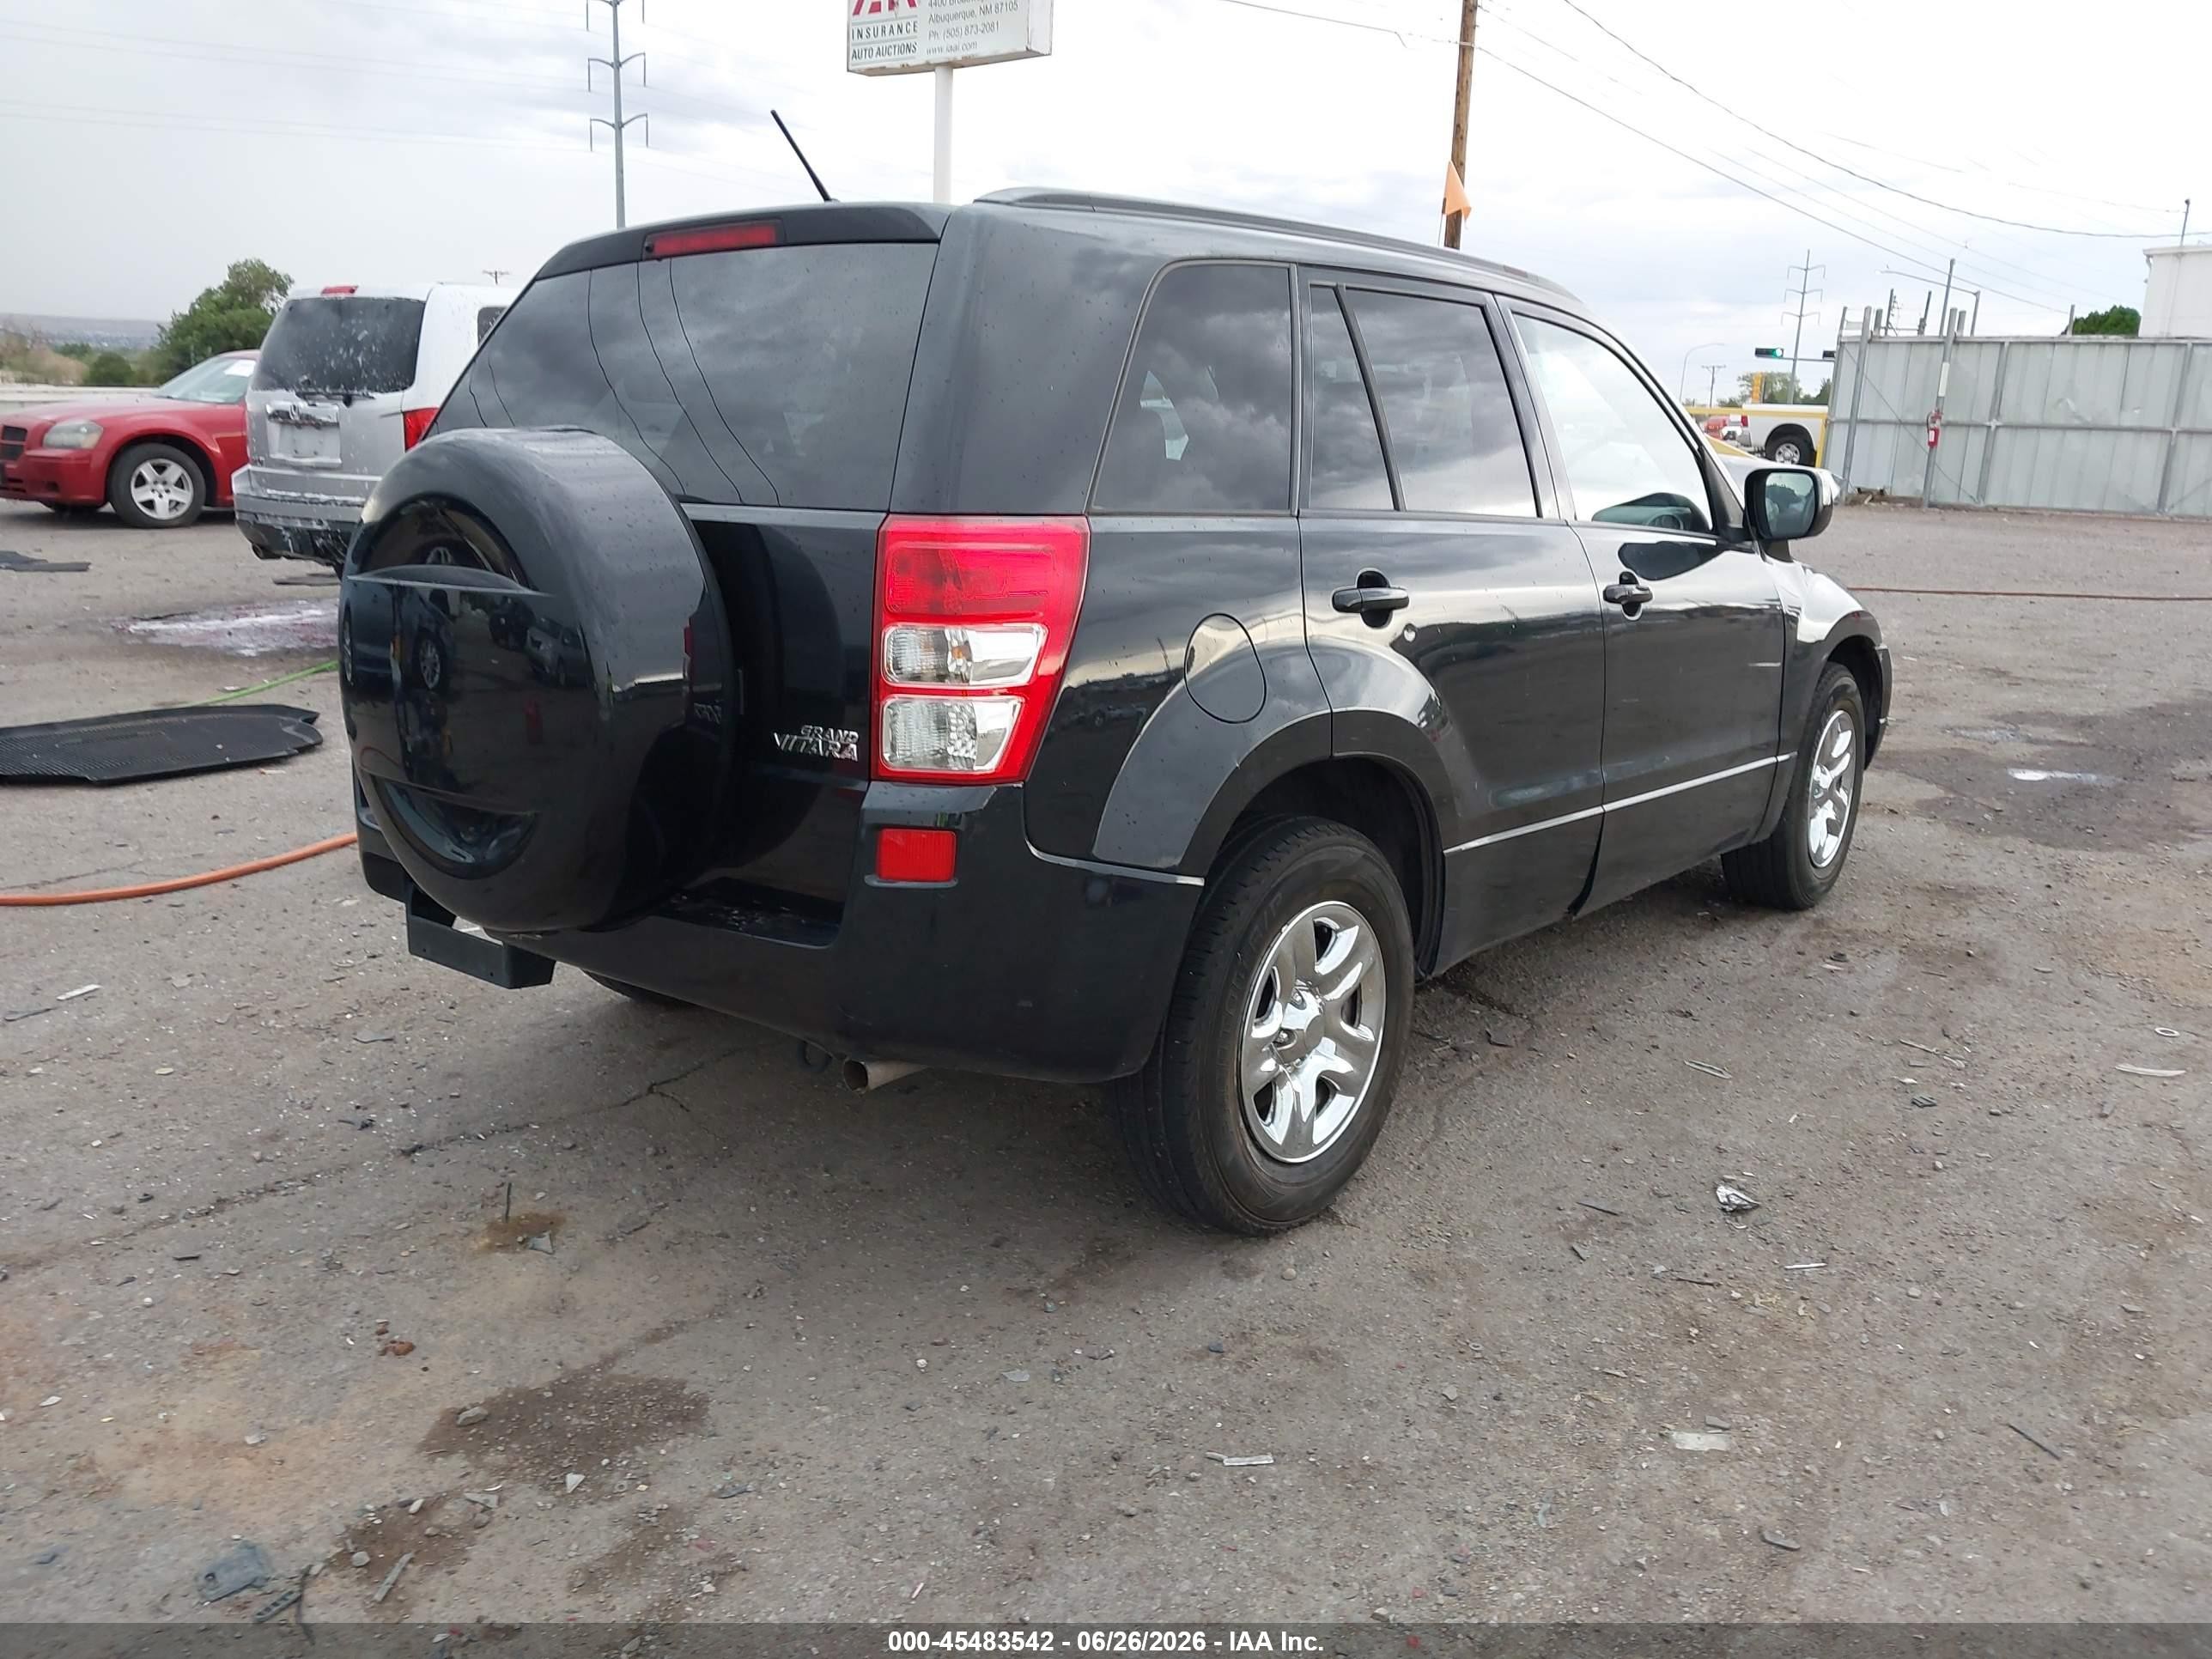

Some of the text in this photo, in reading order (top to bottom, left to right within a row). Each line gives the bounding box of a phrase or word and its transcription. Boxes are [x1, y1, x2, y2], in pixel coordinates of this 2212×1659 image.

[979, 3, 993, 15] NM
[994, 0, 1018, 15] 87105
[852, 21, 918, 41] INSURANCE
[942, 27, 963, 40] (505)
[964, 20, 1000, 35] 873-2081
[852, 41, 918, 61] AUTO AUCTIONS
[800, 725, 860, 744] GRAND
[774, 732, 859, 763] VITARA
